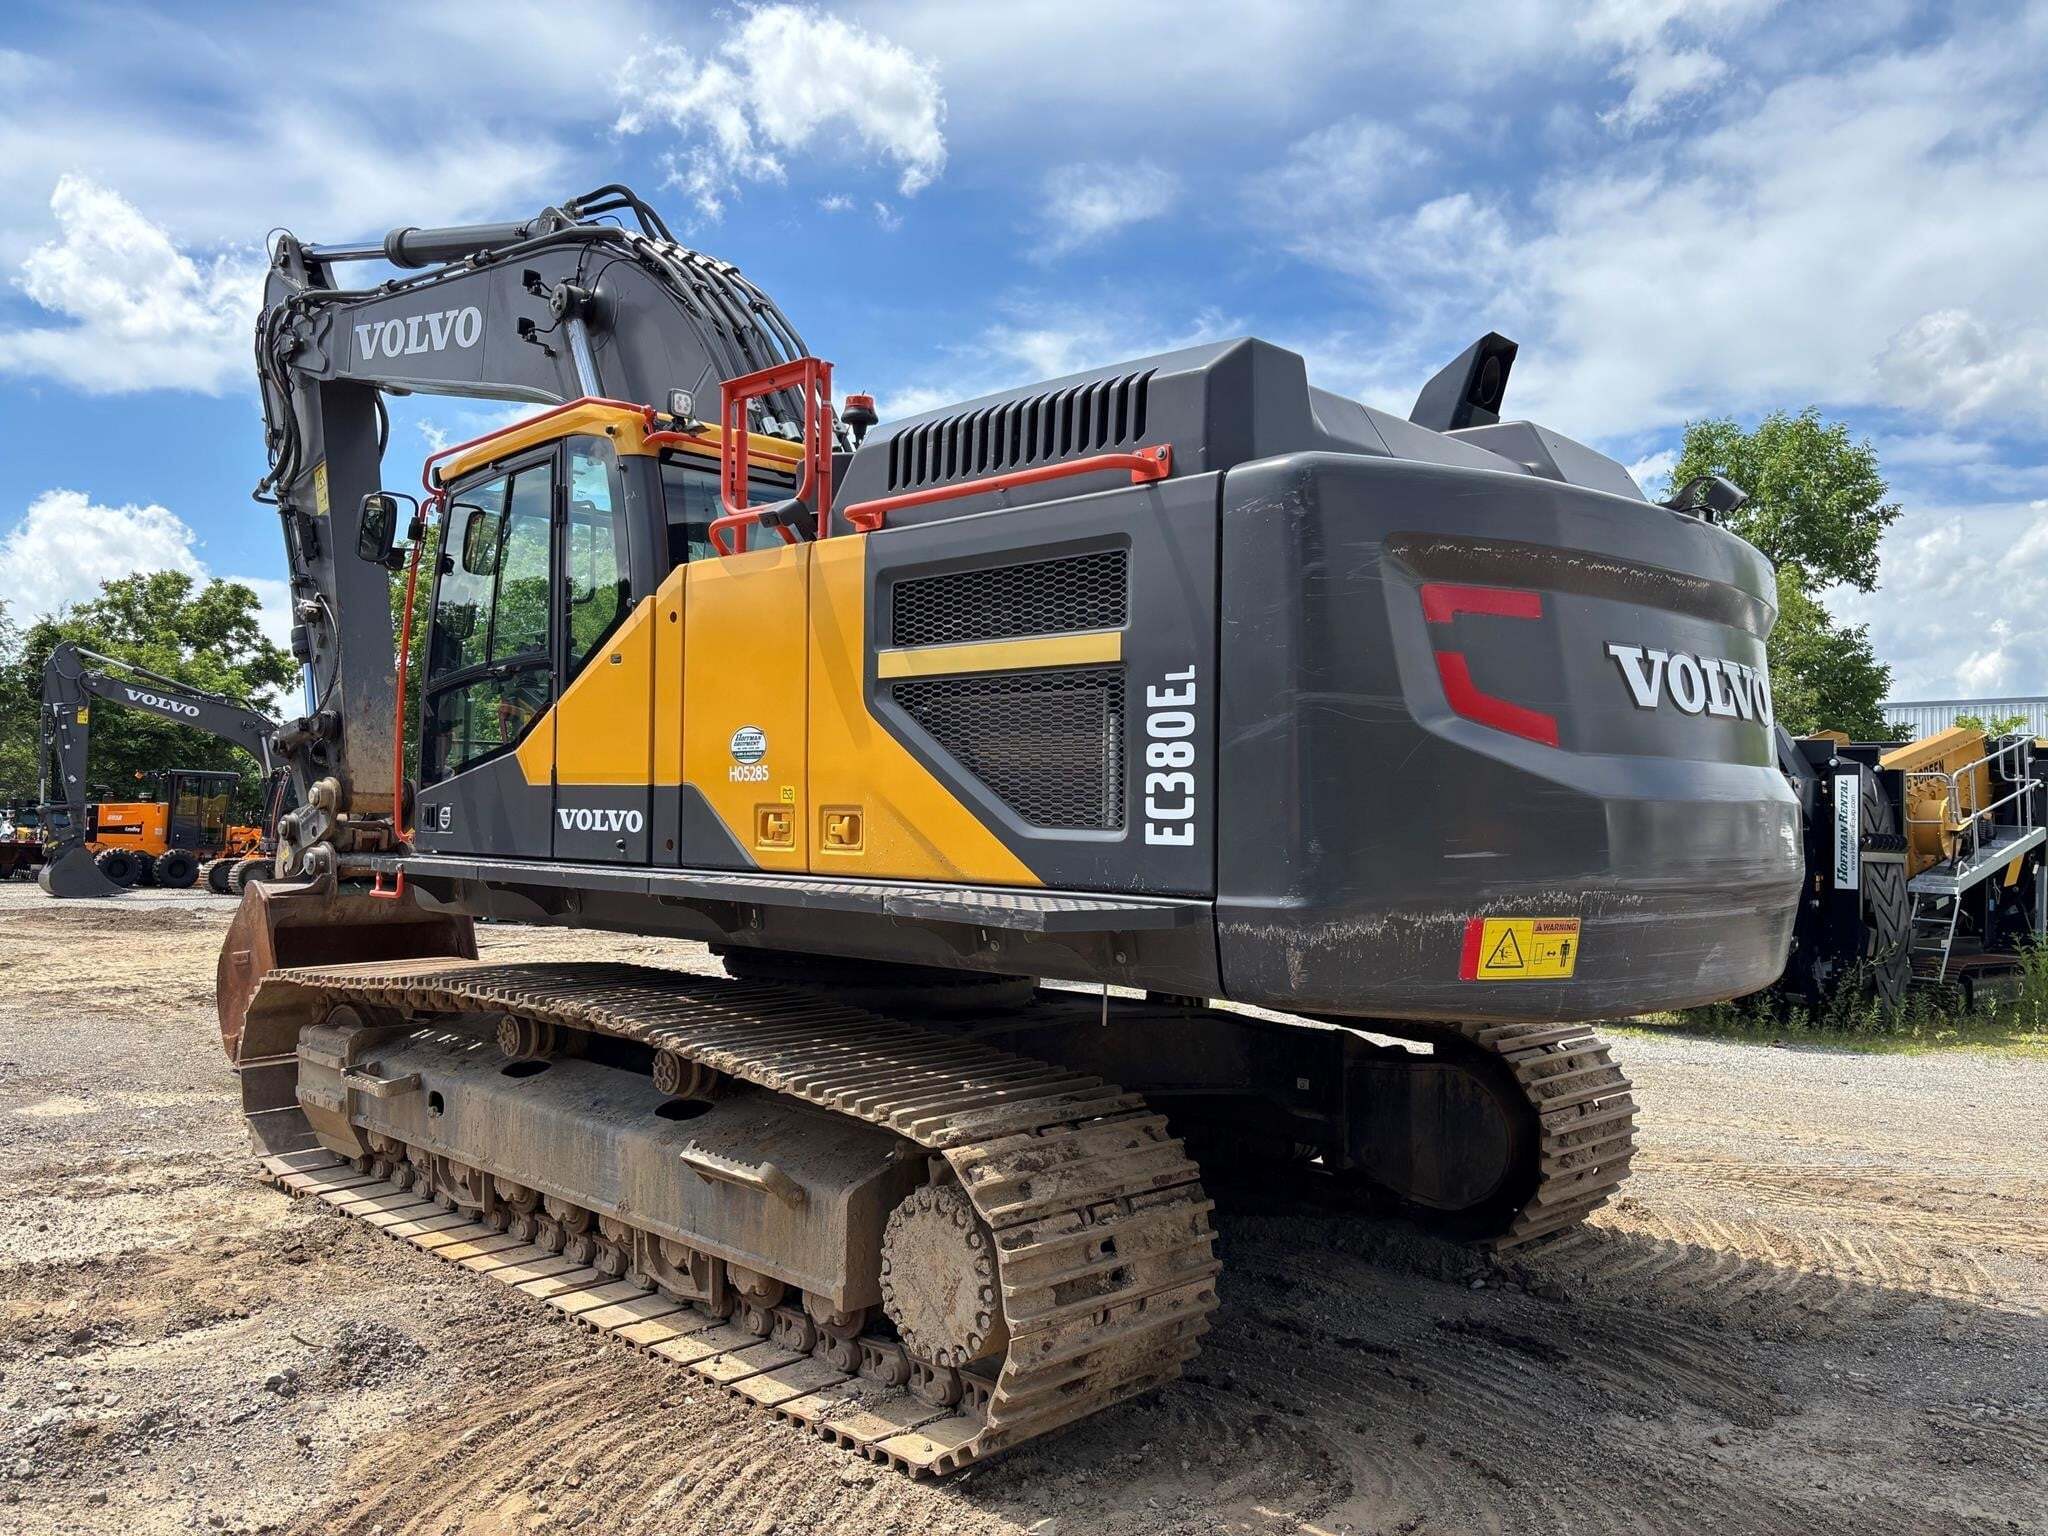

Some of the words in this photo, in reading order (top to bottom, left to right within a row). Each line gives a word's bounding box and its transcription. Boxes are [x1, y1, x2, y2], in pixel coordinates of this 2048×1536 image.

[355, 306, 483, 360] VOLVO
[125, 688, 200, 718] VOLVO
[1604, 641, 1772, 727] VOLVO
[1145, 664, 1196, 846] EC380EL
[557, 808, 643, 833] VOLVO
[1838, 779, 1849, 823] RENTAL
[1837, 826, 1848, 885] HOFFMAN
[1543, 923, 1577, 931] WARNING
